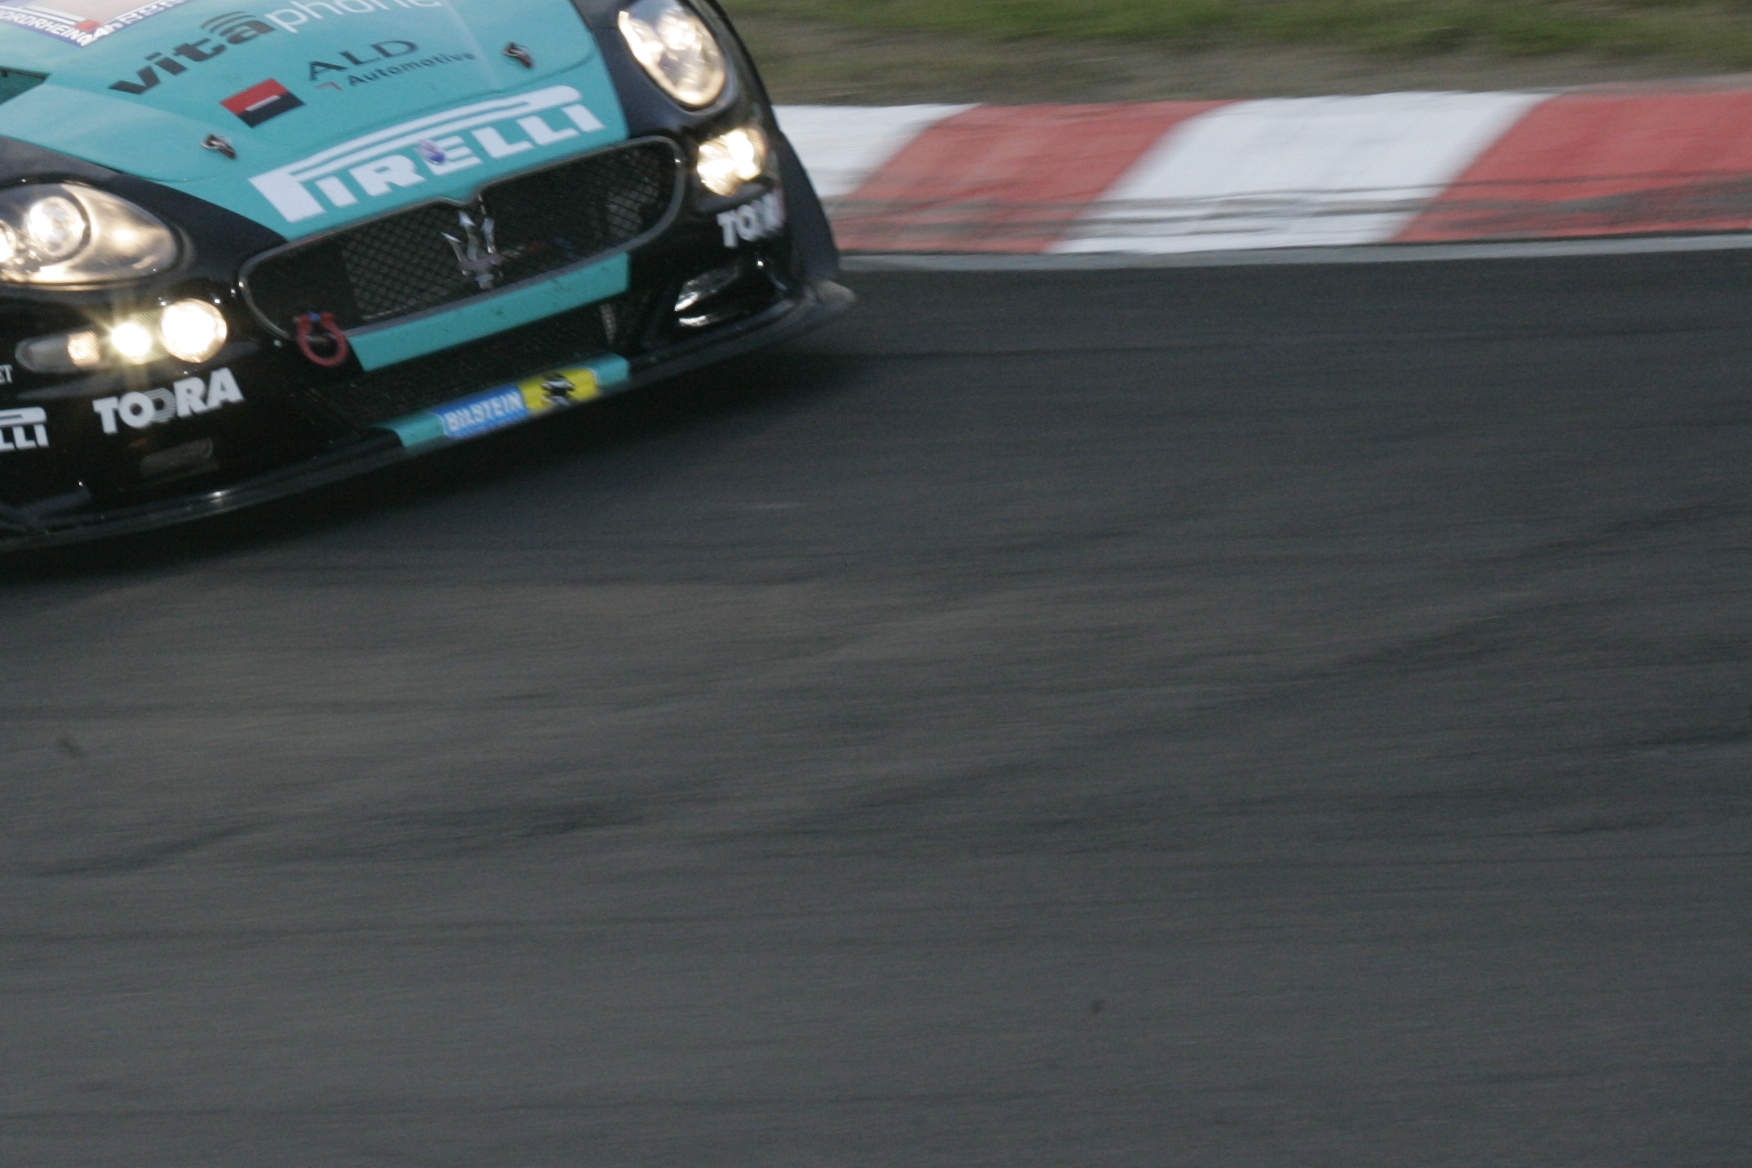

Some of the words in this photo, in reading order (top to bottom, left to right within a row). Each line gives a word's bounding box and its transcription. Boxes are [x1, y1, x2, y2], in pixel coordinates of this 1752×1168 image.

[308, 39, 418, 81] ALD
[346, 52, 479, 87] Automotive
[248, 84, 606, 224] PIRELLI
[92, 367, 245, 435] TOORA
[443, 389, 523, 432] BILSTEIN
